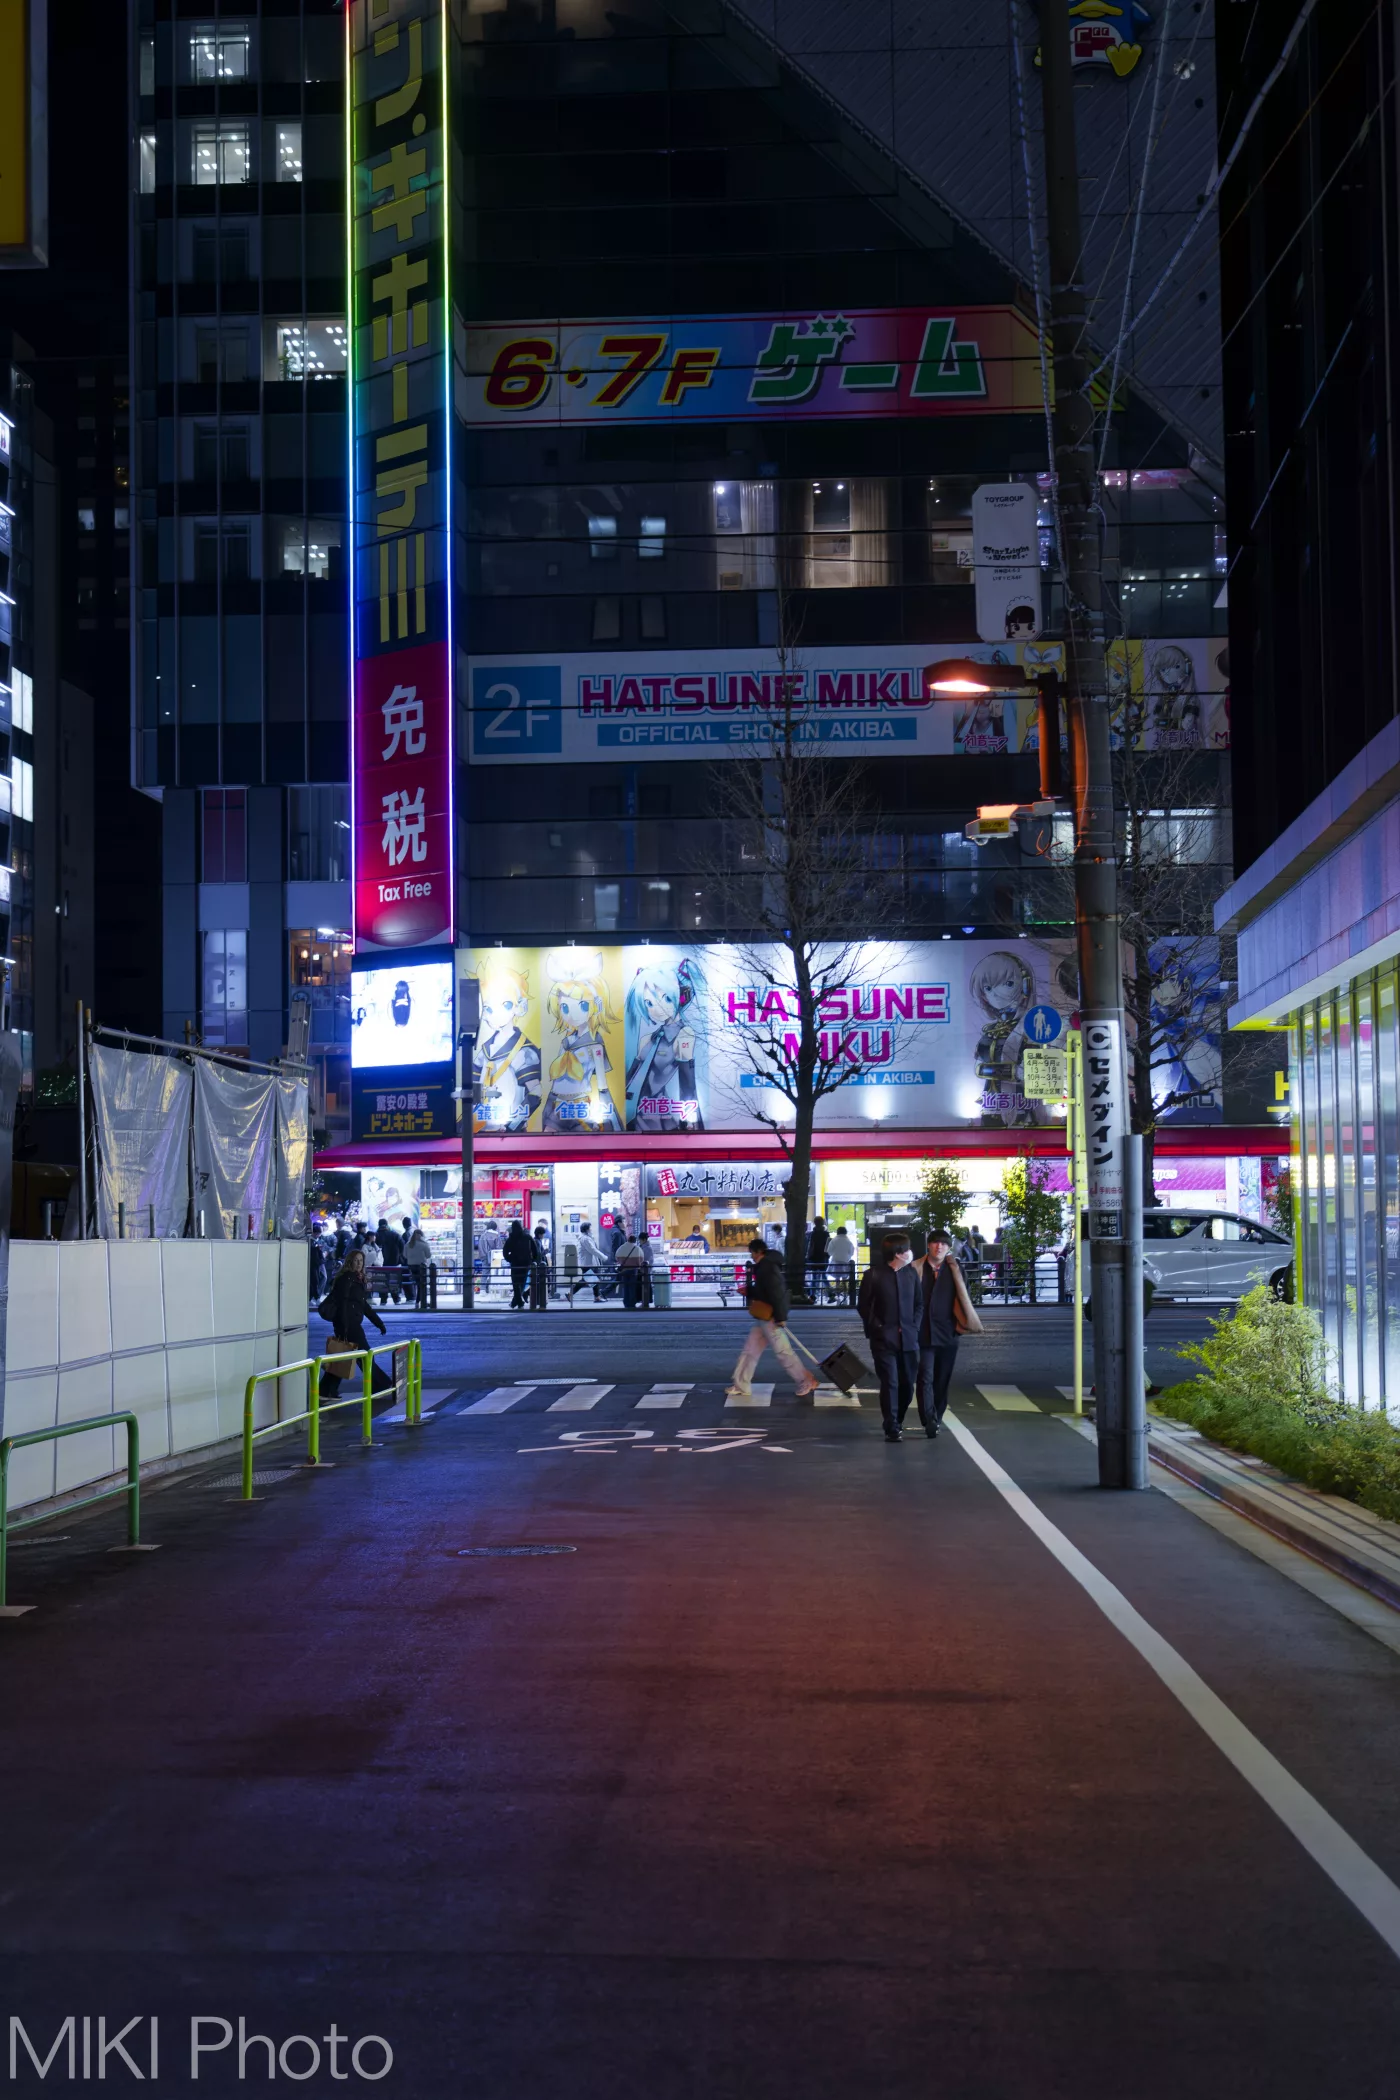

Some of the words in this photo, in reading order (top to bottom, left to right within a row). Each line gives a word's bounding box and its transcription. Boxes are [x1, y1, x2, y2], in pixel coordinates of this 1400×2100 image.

[748, 313, 988, 403] ゲーム
[984, 495, 1025, 503] TOYGROUP
[581, 673, 804, 714] HATSUNE
[818, 672, 931, 708] MIKU
[484, 683, 552, 739] 2F
[618, 723, 720, 743] OFFICIAL
[800, 722, 820, 739] IN
[830, 721, 896, 739] AKIBA
[381, 684, 428, 867] 免税
[378, 884, 401, 903] Tax
[404, 881, 432, 899] Free
[784, 1031, 890, 1064] MIKU
[864, 1073, 877, 1085] IN
[882, 1072, 923, 1084] AKIBA
[376, 1093, 429, 1112] 驚安の殿堂
[555, 1101, 614, 1121] 鏡音ン
[638, 1096, 699, 1121] 初音ミク
[1088, 1056, 1114, 1166] セメダイン
[600, 1162, 622, 1213] 牛串
[680, 1169, 775, 1193] 丸十精肉店
[1096, 1226, 1117, 1235] 3-13
